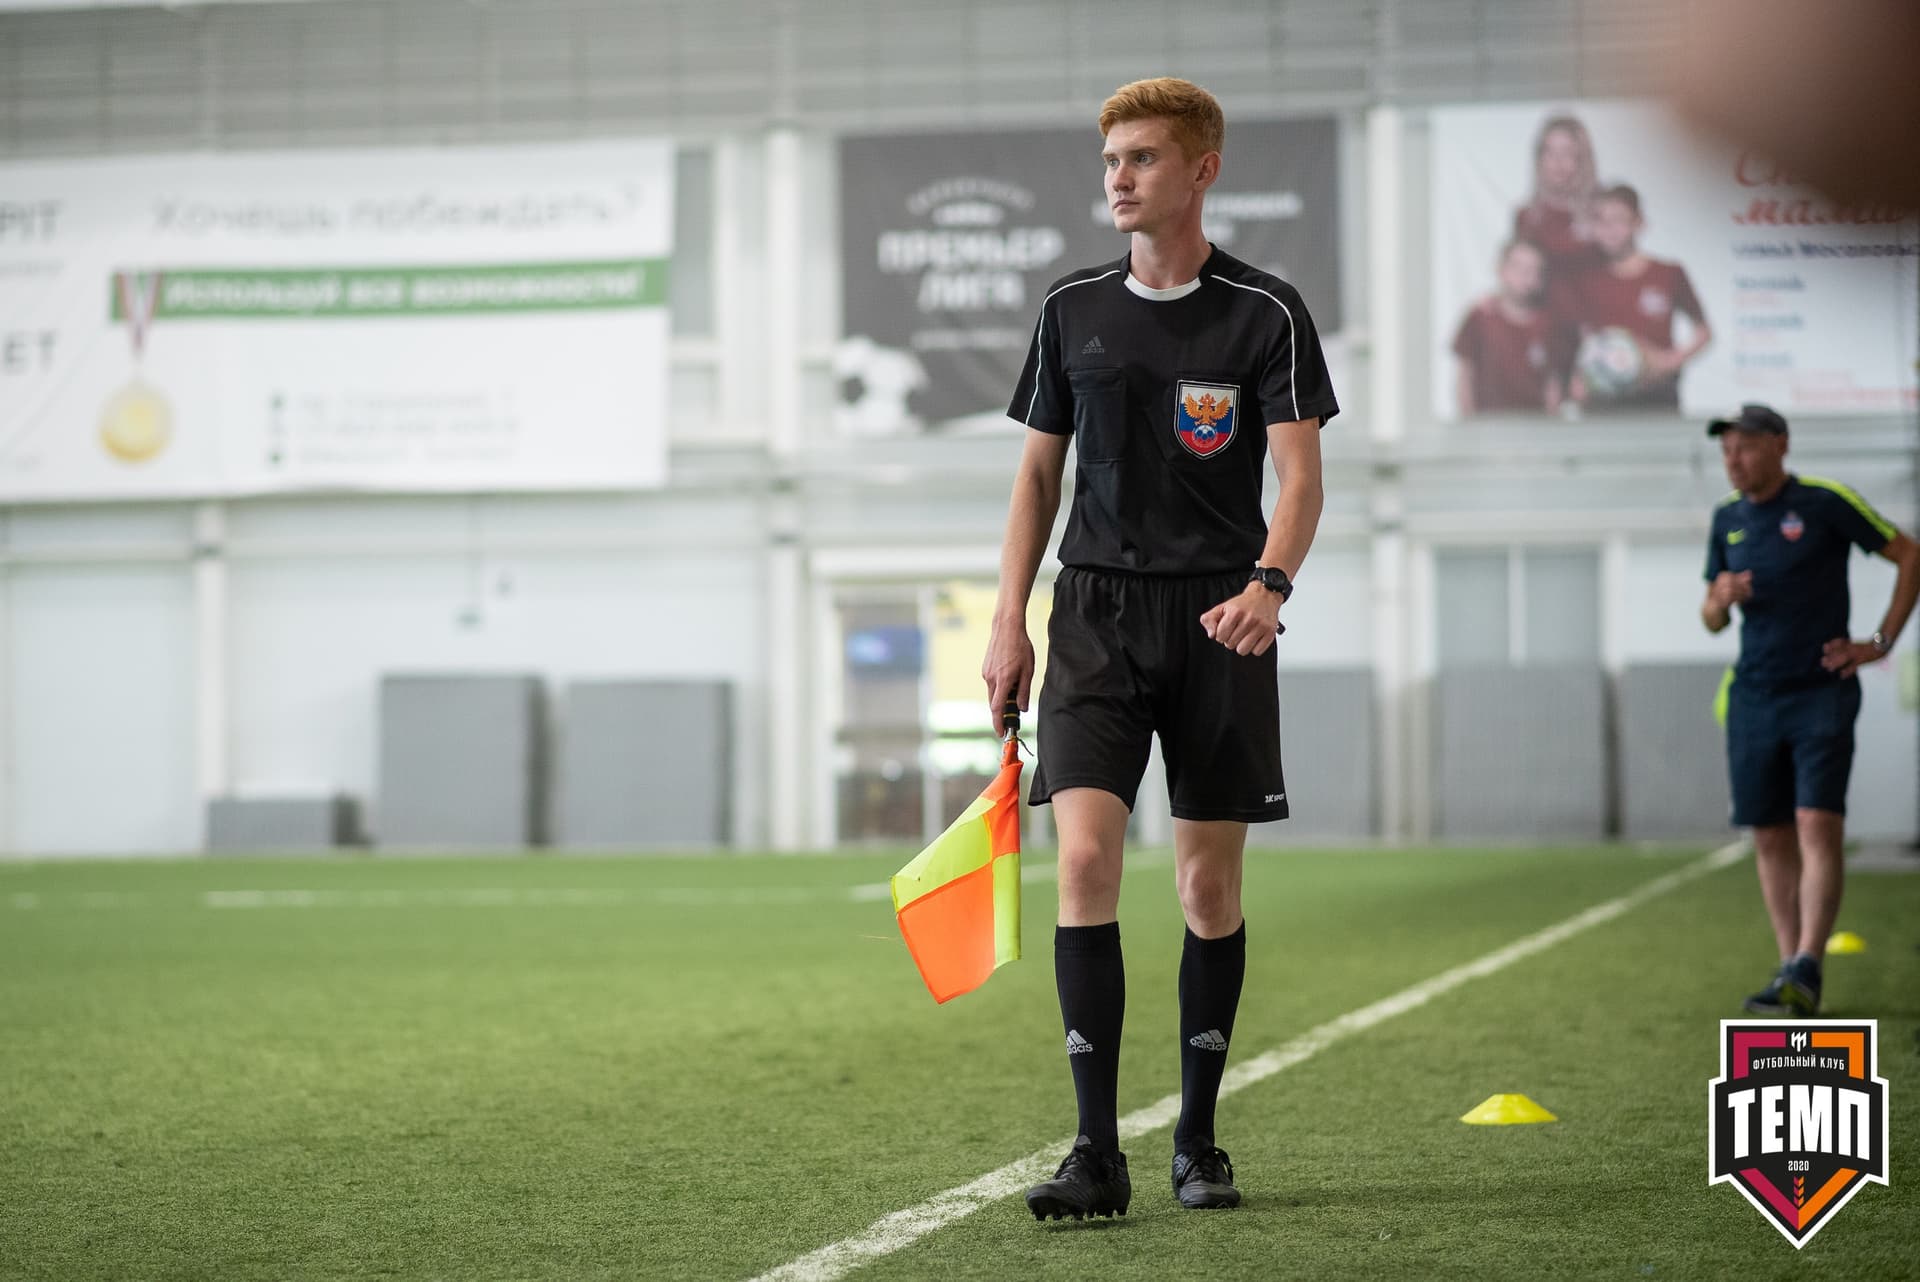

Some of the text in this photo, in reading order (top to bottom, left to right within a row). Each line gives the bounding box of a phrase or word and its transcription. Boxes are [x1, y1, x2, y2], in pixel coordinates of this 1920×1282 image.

[878, 228, 1065, 272] ПРЕМЬЕР
[919, 272, 1025, 312] ЛИГА
[1190, 1038, 1227, 1051] adidas
